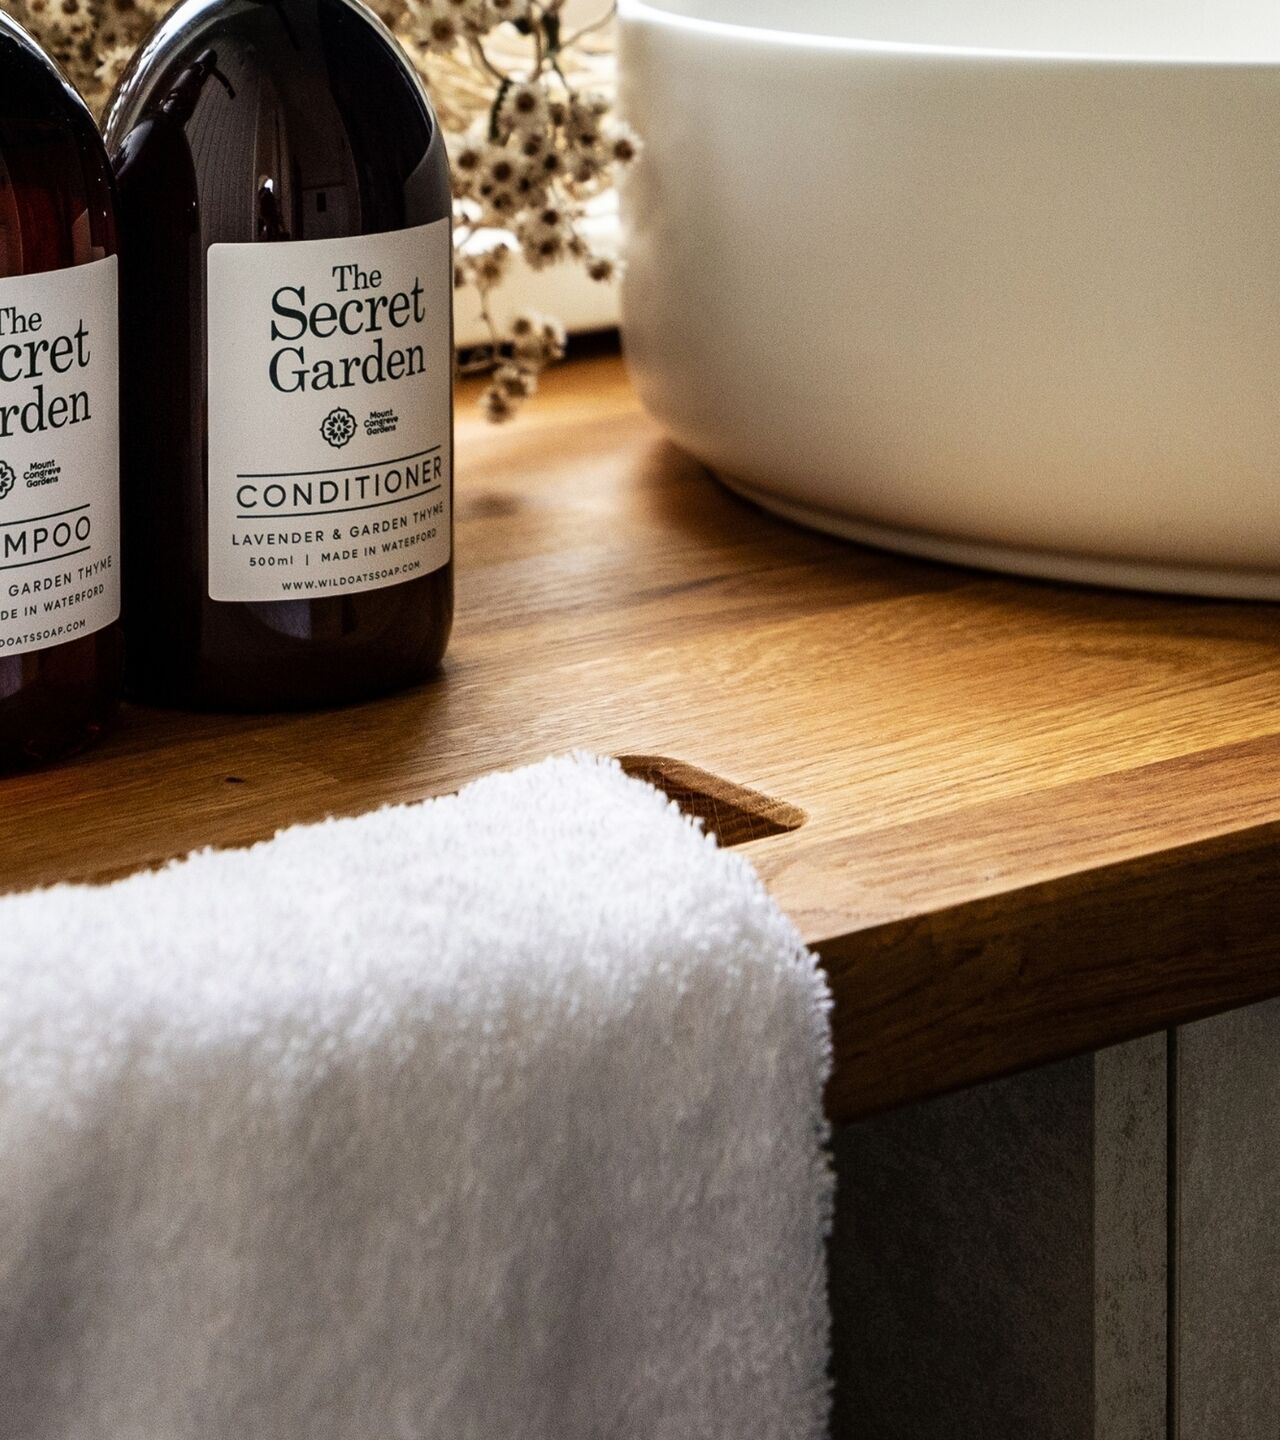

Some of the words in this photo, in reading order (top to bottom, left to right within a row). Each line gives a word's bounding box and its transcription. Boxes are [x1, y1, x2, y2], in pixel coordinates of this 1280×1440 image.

[332, 264, 382, 293] The
[270, 276, 426, 341] Secret
[268, 338, 426, 393] Garden
[366, 423, 397, 435] Gardens
[369, 409, 393, 419] Mount
[23, 466, 61, 481] Congreve
[29, 459, 55, 471] Mount
[26, 475, 59, 488] Gardens
[236, 456, 442, 508] CONDITIONER
[232, 530, 324, 546] LAVENDER
[333, 528, 342, 540] &
[350, 516, 408, 538] GARDEN
[413, 502, 444, 525] THYME
[249, 555, 294, 567] 500ml
[321, 548, 359, 563] MADE
[364, 545, 377, 556] IN
[381, 528, 437, 554] WATERFORD
[8, 573, 72, 598] GARDEN
[78, 555, 113, 581] THYME
[282, 560, 421, 591] WWW.WILDOATSSOAP.COM
[24, 606, 38, 616] IN
[43, 584, 105, 613] WATERFORD
